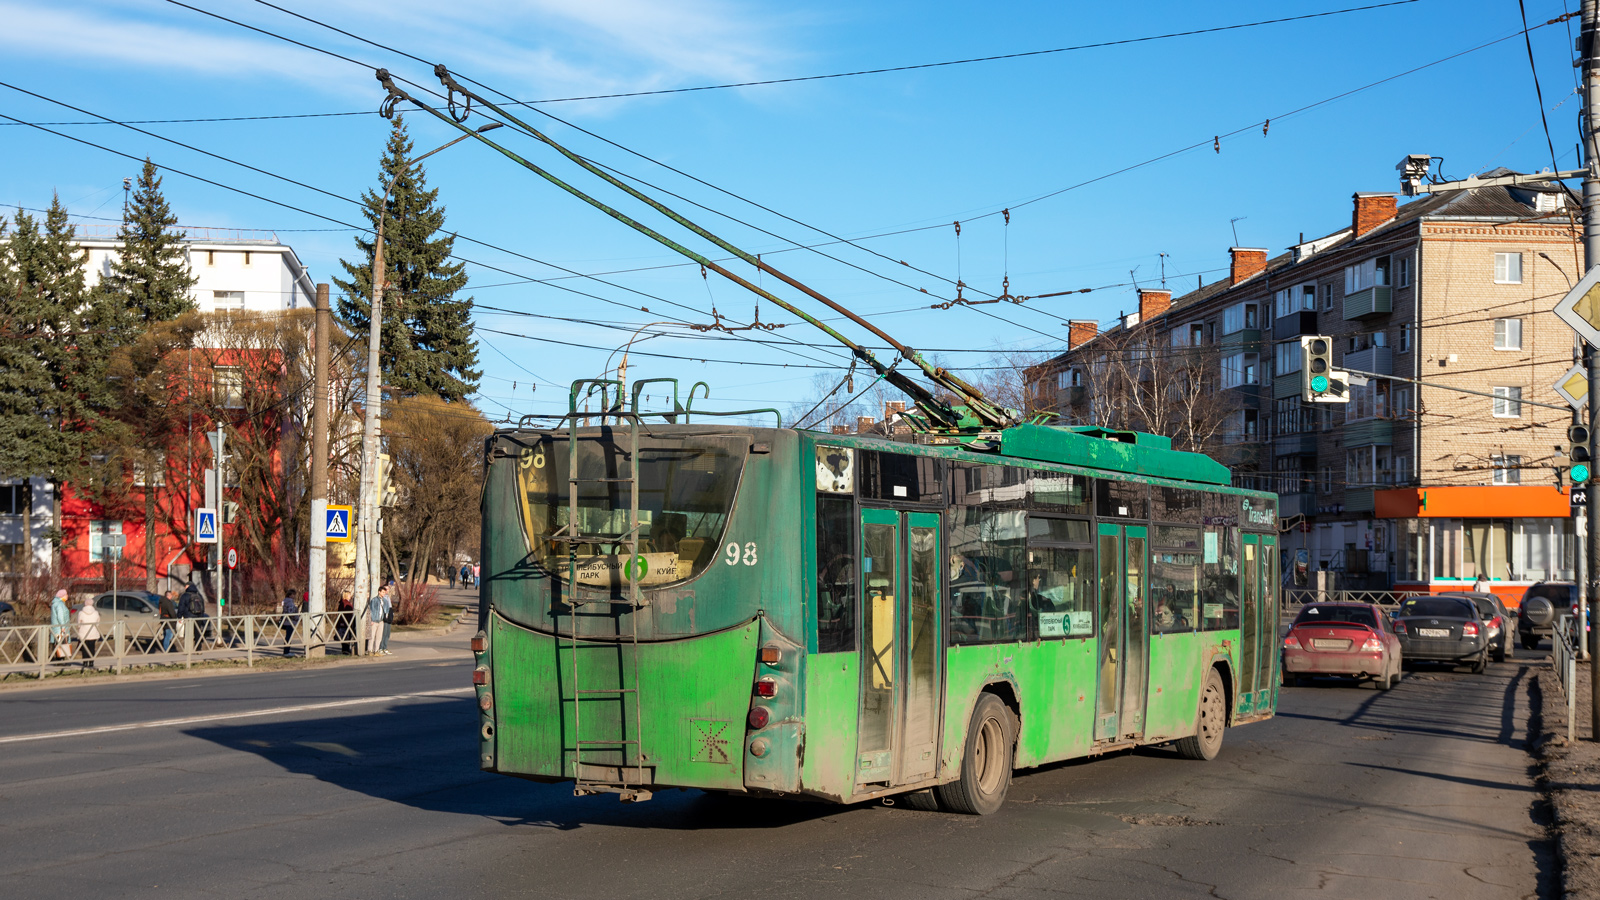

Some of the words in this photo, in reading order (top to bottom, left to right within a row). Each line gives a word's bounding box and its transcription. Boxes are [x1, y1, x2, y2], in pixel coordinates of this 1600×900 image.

[520, 443, 546, 469] 98
[725, 541, 758, 566] 98
[1064, 614, 1071, 635] 5
